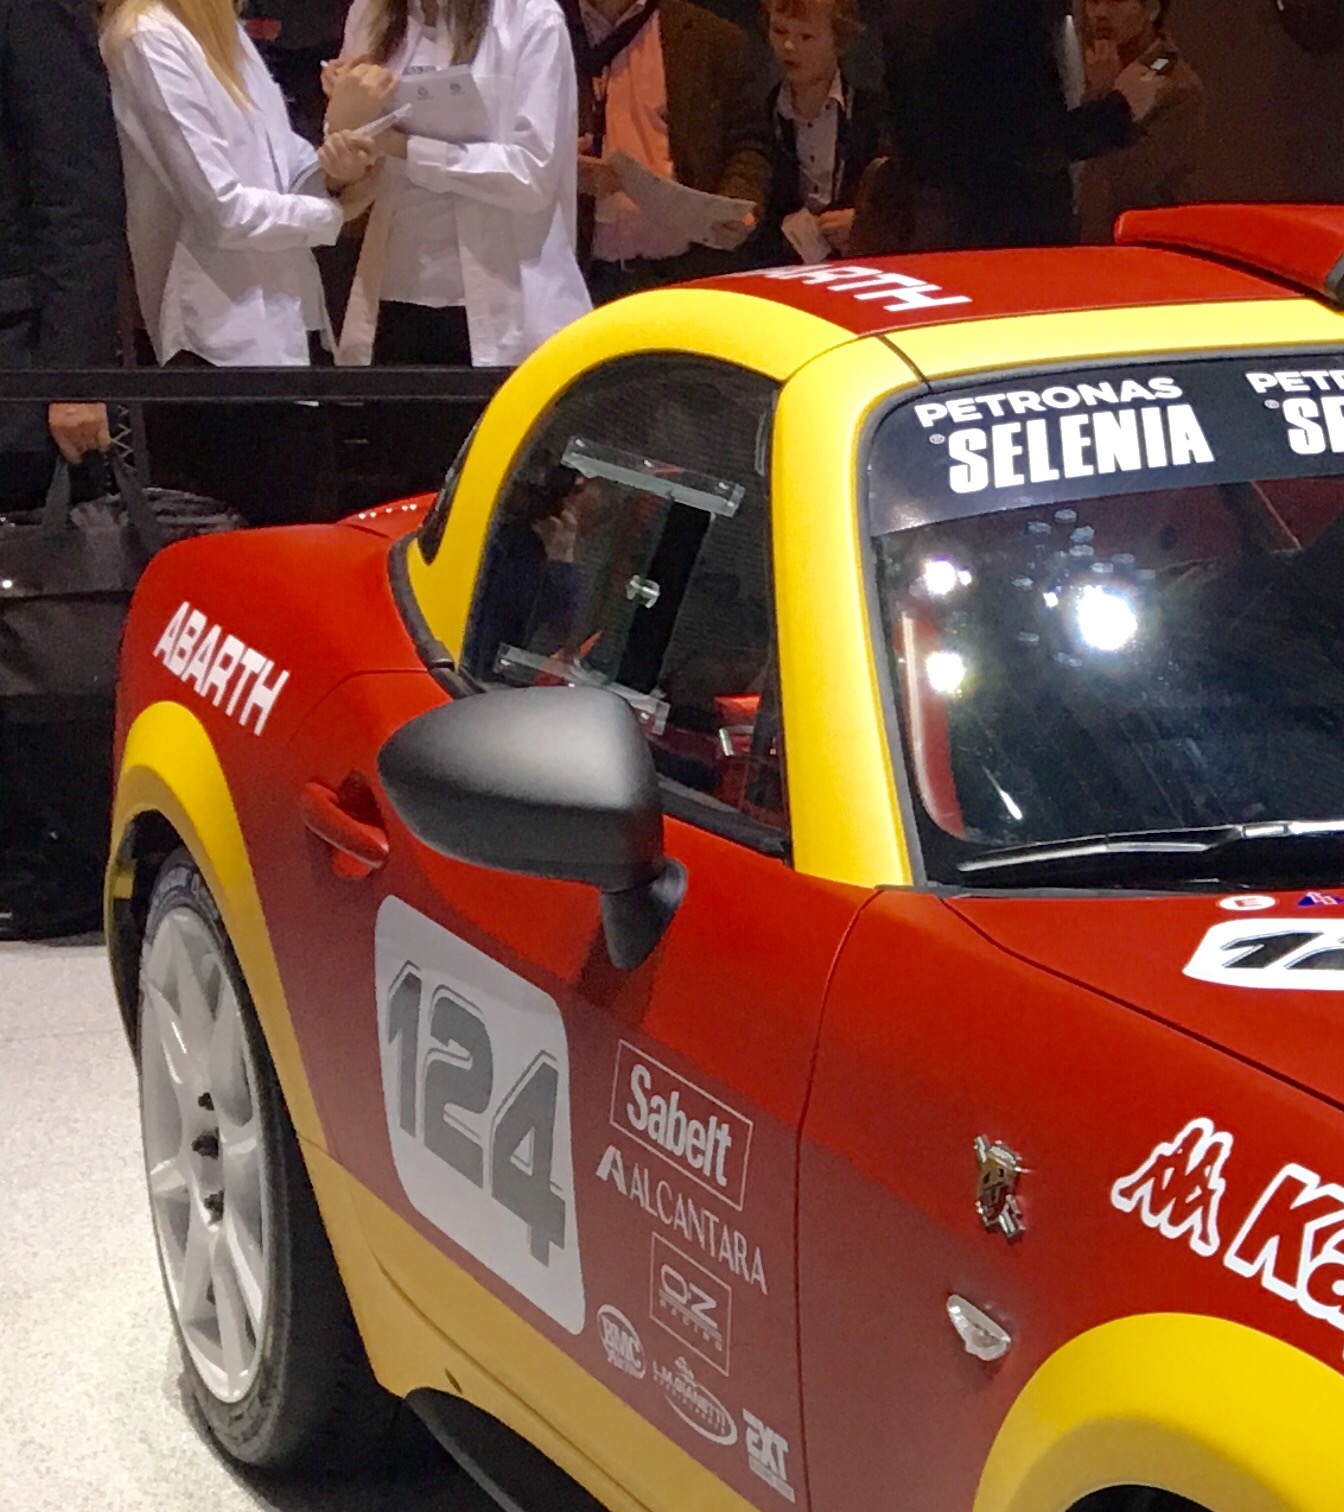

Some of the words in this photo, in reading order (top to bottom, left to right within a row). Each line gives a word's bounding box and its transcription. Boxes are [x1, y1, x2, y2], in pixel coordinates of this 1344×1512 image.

[724, 262, 973, 313] ARTH
[914, 377, 1183, 427] PETRONAS
[948, 403, 1215, 494] SELENIA
[152, 600, 290, 736] ABARTH
[387, 959, 567, 1268] 124
[626, 1063, 732, 1188] Sabelt
[629, 1162, 769, 1295] ALCANTARA
[660, 1264, 719, 1329] OZ
